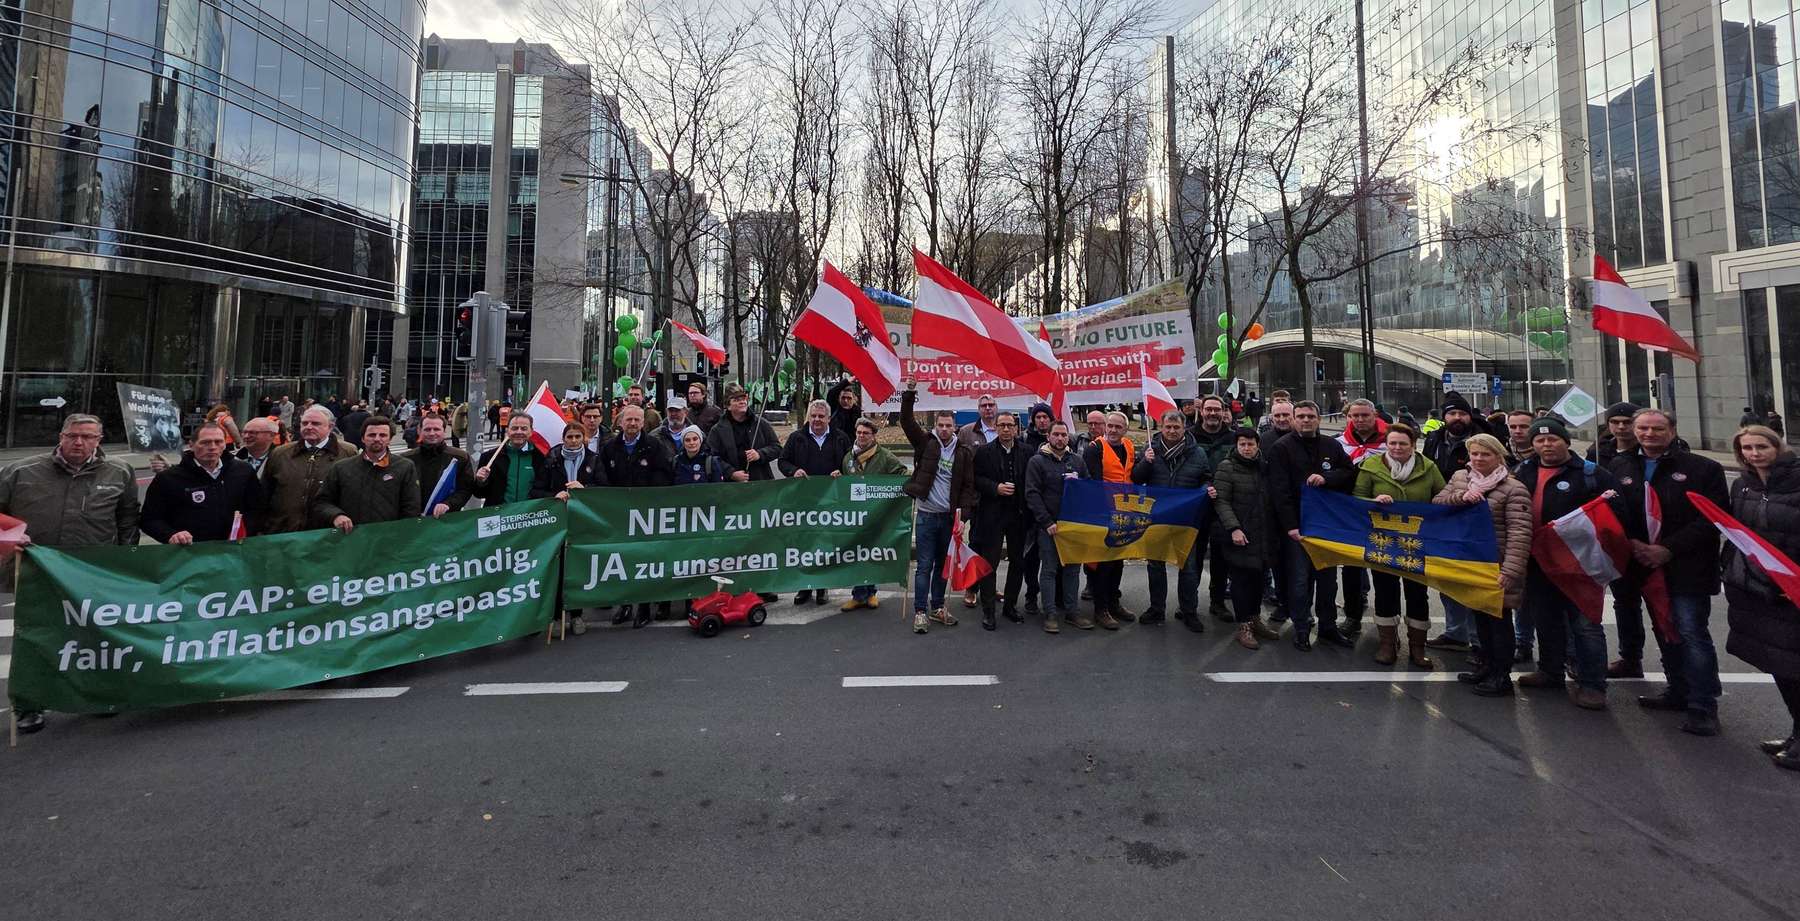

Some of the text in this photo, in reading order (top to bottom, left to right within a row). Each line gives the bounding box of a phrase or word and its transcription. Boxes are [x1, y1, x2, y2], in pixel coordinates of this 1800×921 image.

[1074, 331, 1099, 347] NO
[1105, 320, 1182, 342] FUTURE.
[907, 360, 952, 374] Don't
[1059, 351, 1152, 370] farms with
[937, 378, 1016, 390] Mercosur
[1061, 369, 1132, 386] Ukraine!
[1493, 377, 1500, 387] P
[131, 390, 146, 400] Für
[500, 510, 549, 524] STEIRISCHER
[501, 517, 557, 532] BAUERNBUND
[628, 506, 868, 536] NEIN zu Mercosur
[583, 544, 898, 590] JA zu unseren Betrieben
[61, 546, 538, 627] Neue GAP: eigenständig,
[57, 577, 541, 673] fair, inflationsangepasst
